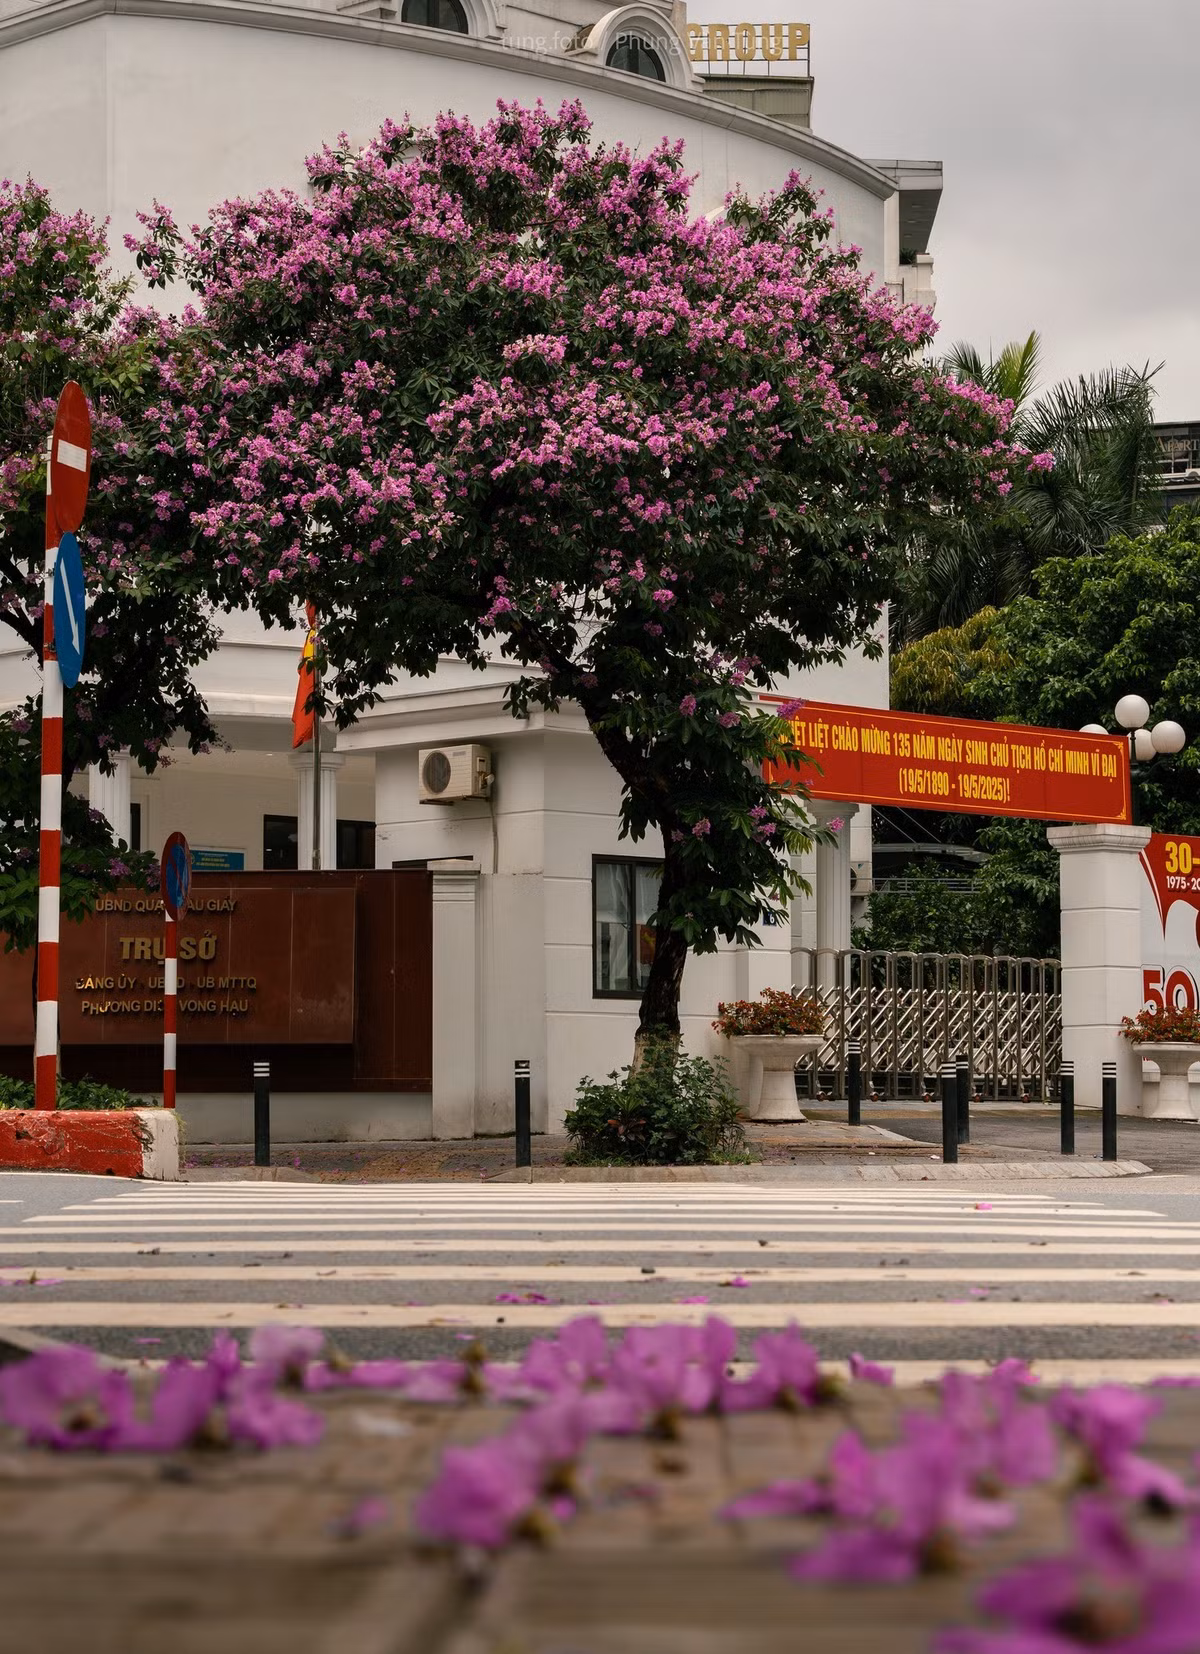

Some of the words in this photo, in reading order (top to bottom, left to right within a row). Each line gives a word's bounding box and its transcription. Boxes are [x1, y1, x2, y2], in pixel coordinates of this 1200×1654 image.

[687, 22, 810, 60] GROUP
[808, 718, 829, 754] LIỆT
[832, 720, 859, 752] CHÀO
[861, 724, 891, 755] MỪNG
[893, 732, 910, 757] 135
[913, 730, 936, 760] NĂM
[938, 733, 963, 763] NGÀY
[966, 739, 988, 766] SINH
[990, 736, 1009, 767] CHỦ
[1011, 744, 1031, 774] TỊCH
[1034, 740, 1046, 771] HỒ
[1048, 744, 1064, 773] CHÍ
[1065, 750, 1089, 775] MINH
[1090, 749, 1101, 776] VĨ
[1102, 754, 1117, 783] ĐẠI
[899, 767, 949, 796] (19/5/1890
[958, 774, 1010, 804] 19/5/2025)!
[95, 899, 132, 912] UBND
[119, 936, 166, 965] TRỤ
[179, 929, 218, 961] SỞ
[148, 976, 185, 989] UBD
[197, 976, 215, 989] UB
[219, 976, 257, 989] MTTQ
